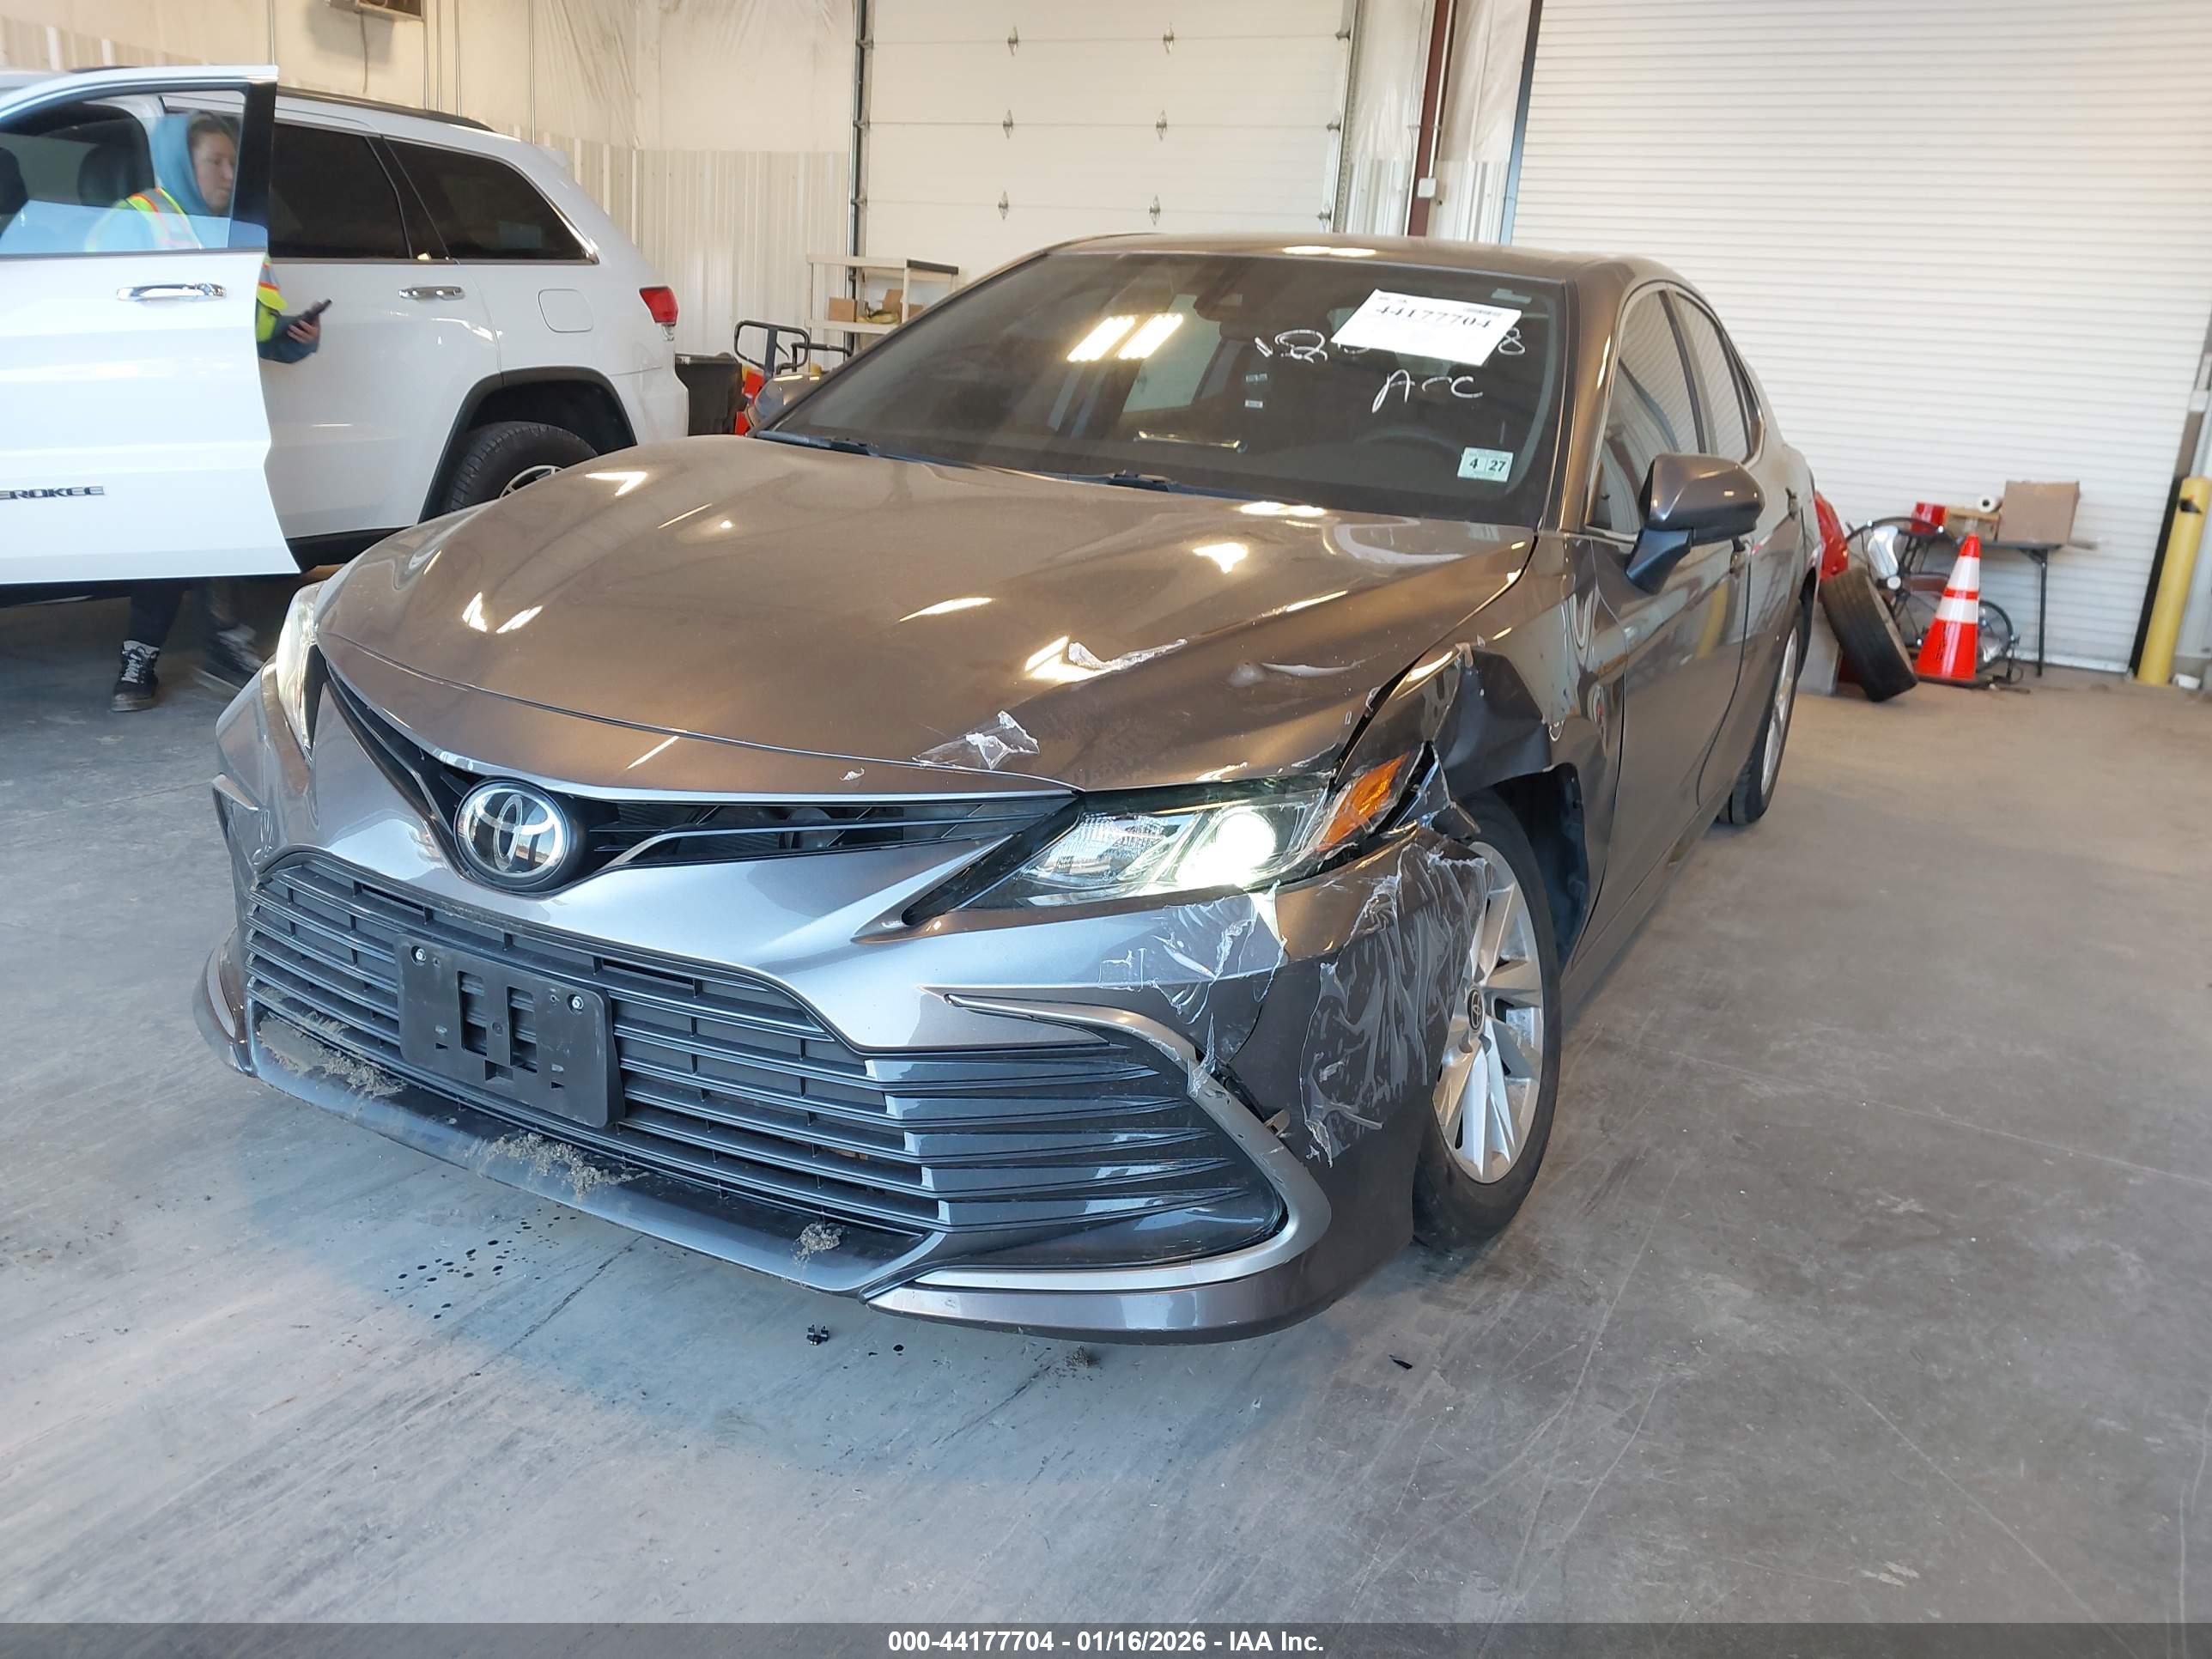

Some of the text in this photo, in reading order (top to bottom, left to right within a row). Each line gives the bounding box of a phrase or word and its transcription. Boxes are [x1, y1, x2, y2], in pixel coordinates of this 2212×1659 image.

[1376, 306, 1492, 328] 44177704
[1469, 458, 1506, 471] 4 27
